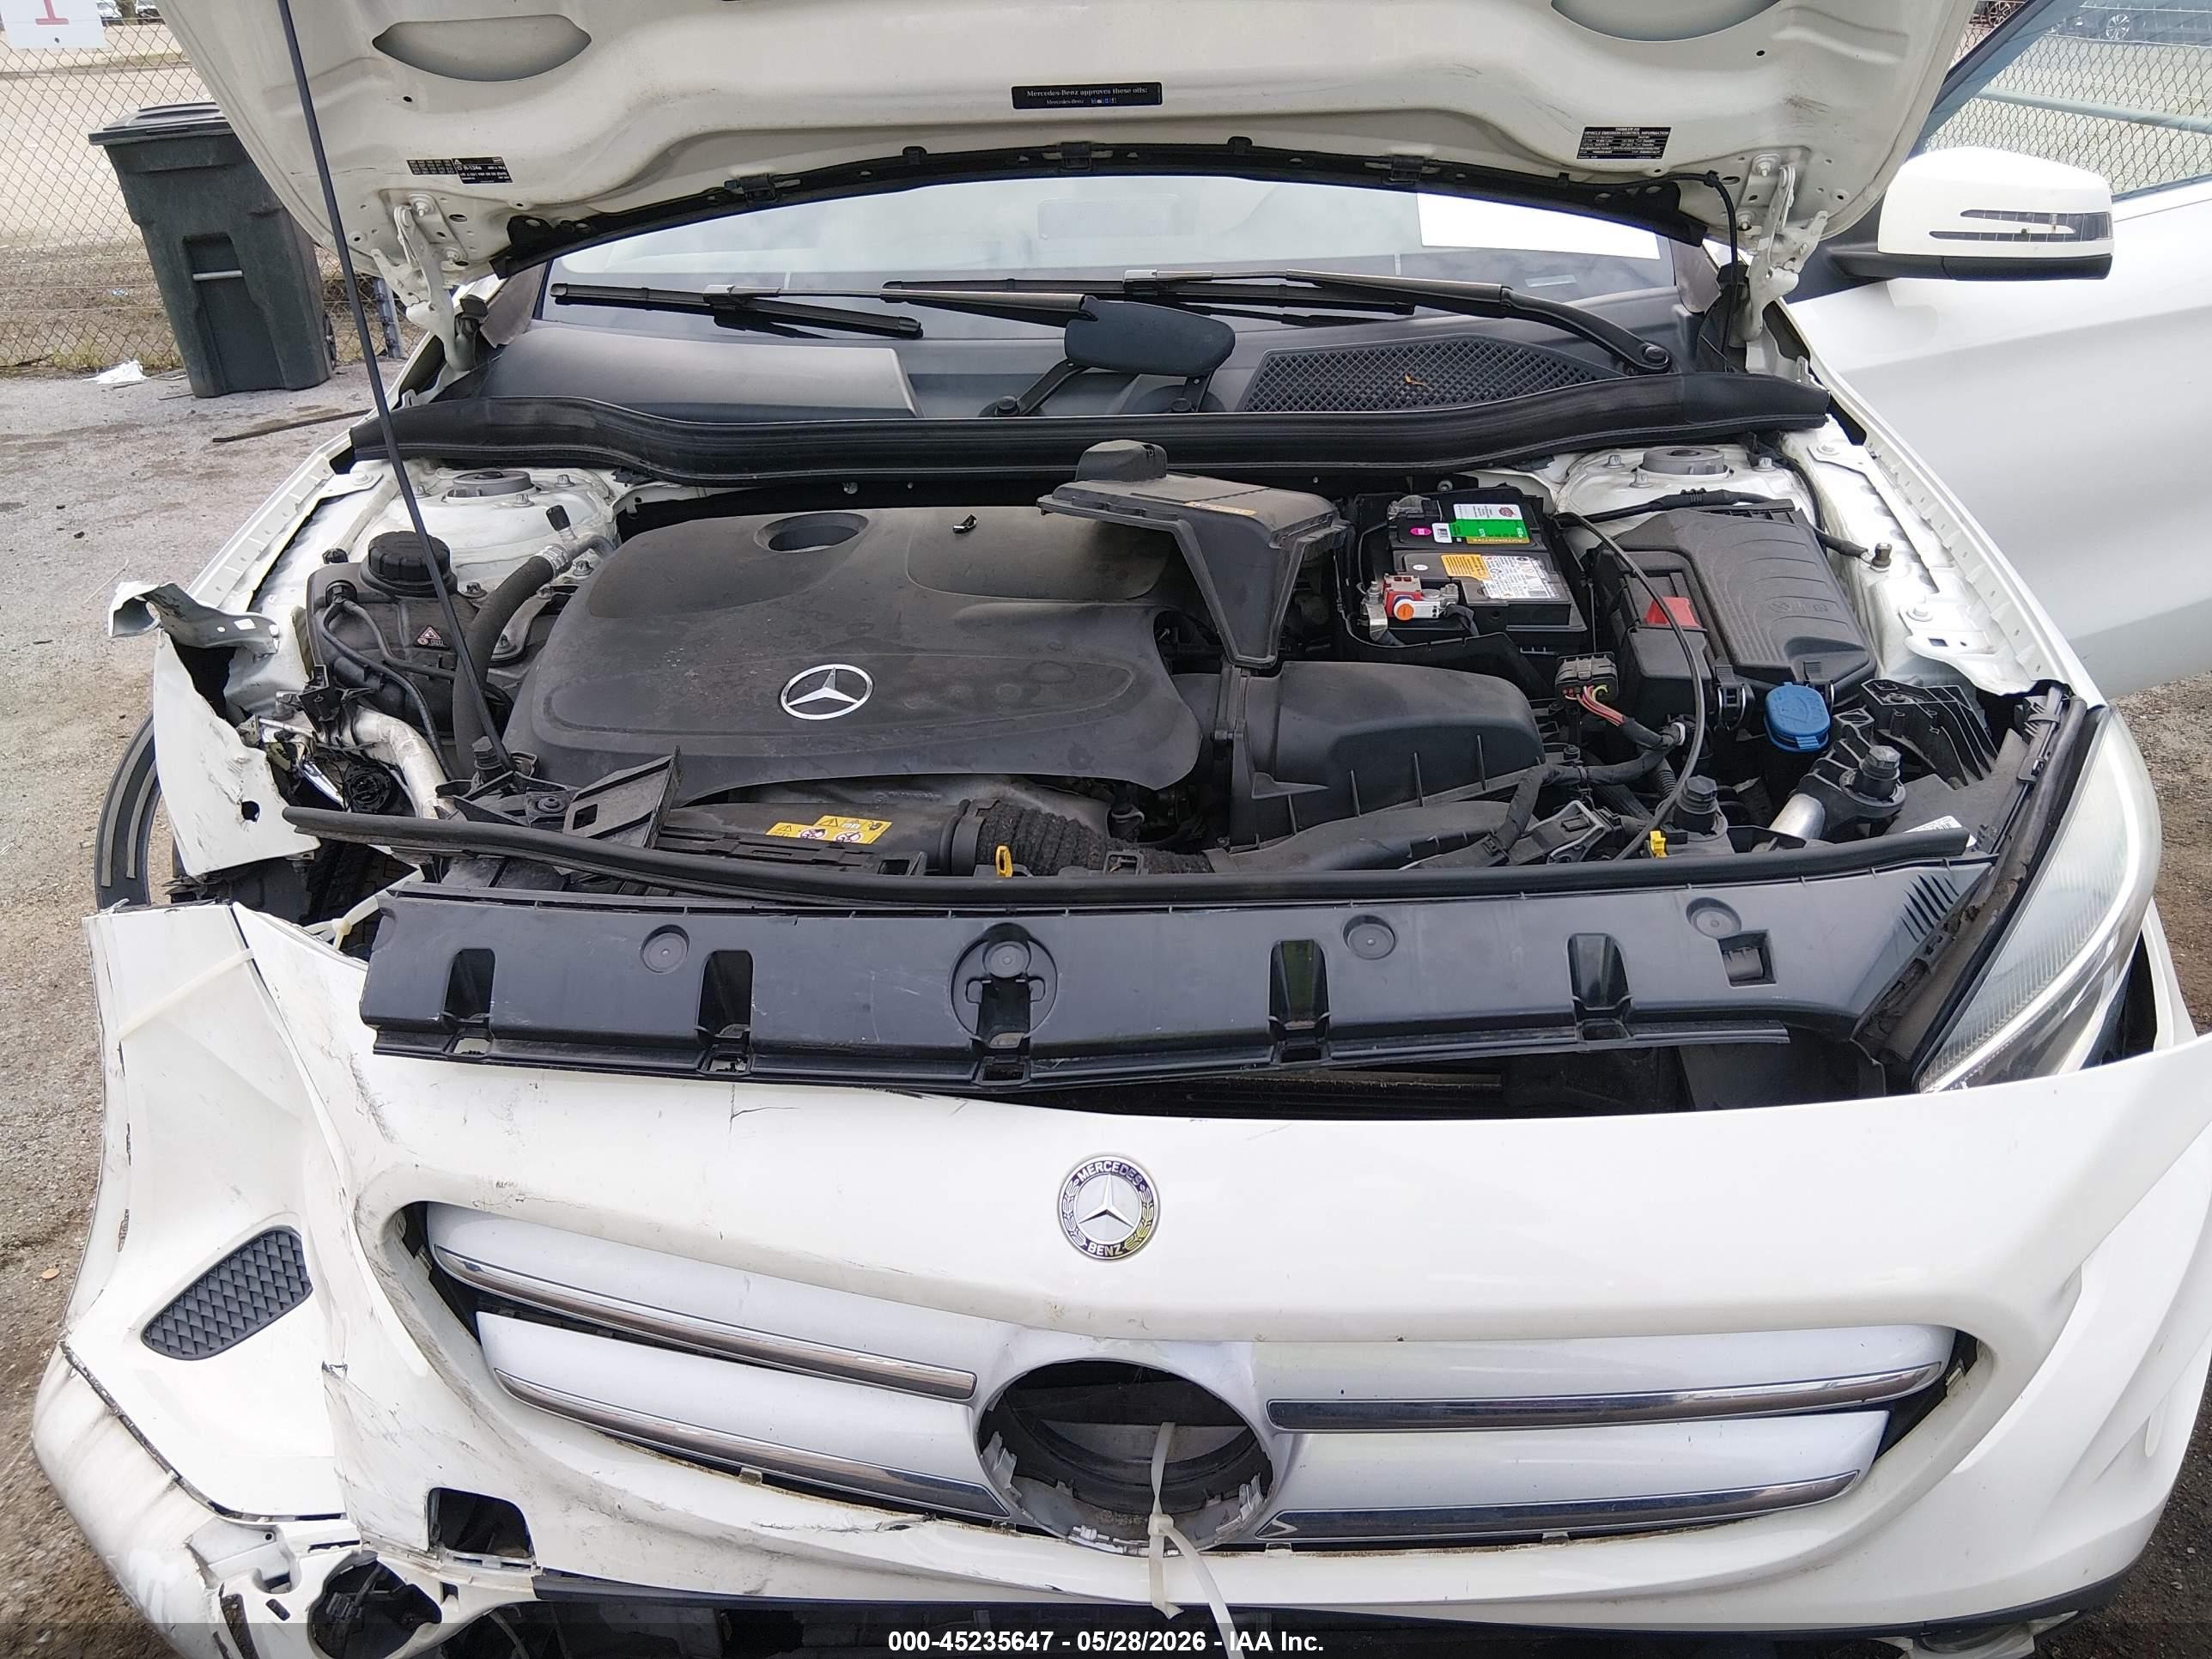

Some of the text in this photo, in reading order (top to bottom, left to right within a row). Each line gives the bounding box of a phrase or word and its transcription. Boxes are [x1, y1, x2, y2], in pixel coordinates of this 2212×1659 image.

[1026, 89, 1079, 98] Mercedes-Benz
[1079, 88, 1112, 97] approves
[1077, 1160, 1143, 1186] MERCEDES
[1087, 1243, 1124, 1257] BENZ
